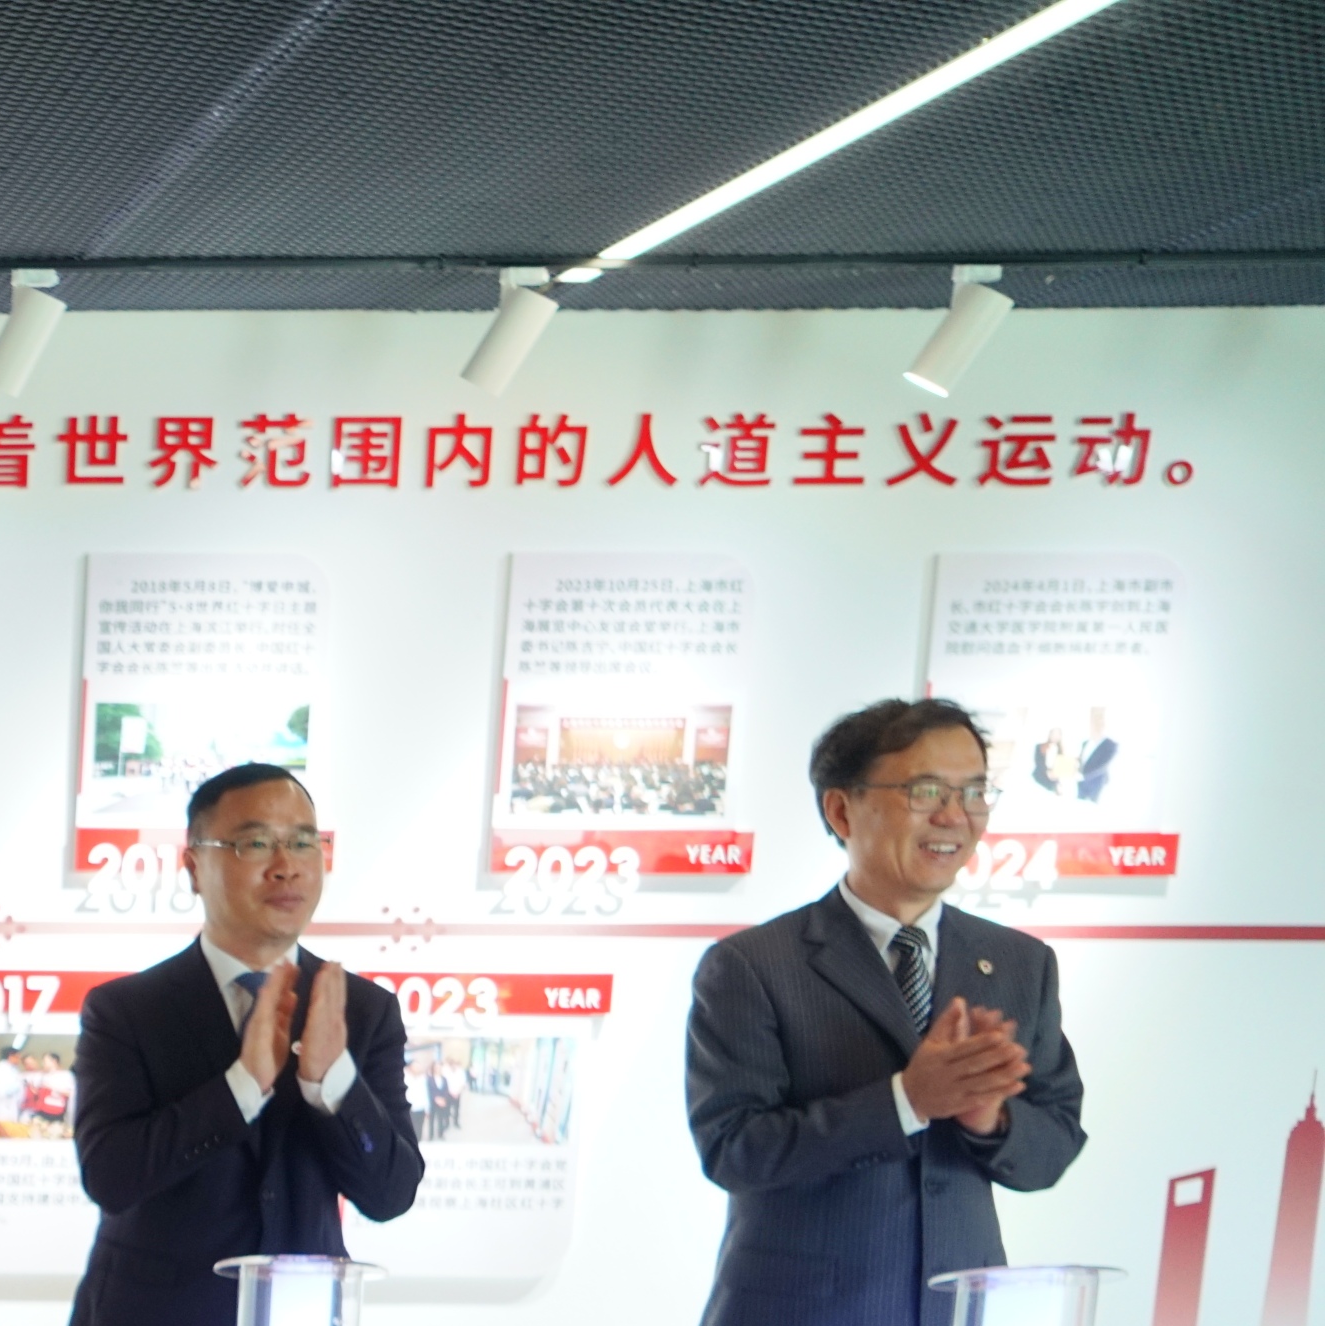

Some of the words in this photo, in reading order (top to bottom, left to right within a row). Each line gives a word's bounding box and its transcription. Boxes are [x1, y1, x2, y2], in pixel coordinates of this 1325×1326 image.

[1108, 845, 1166, 867] YEAR
[505, 846, 640, 894] 2023
[686, 844, 742, 866] YEAR
[545, 987, 601, 1010] YEAR
